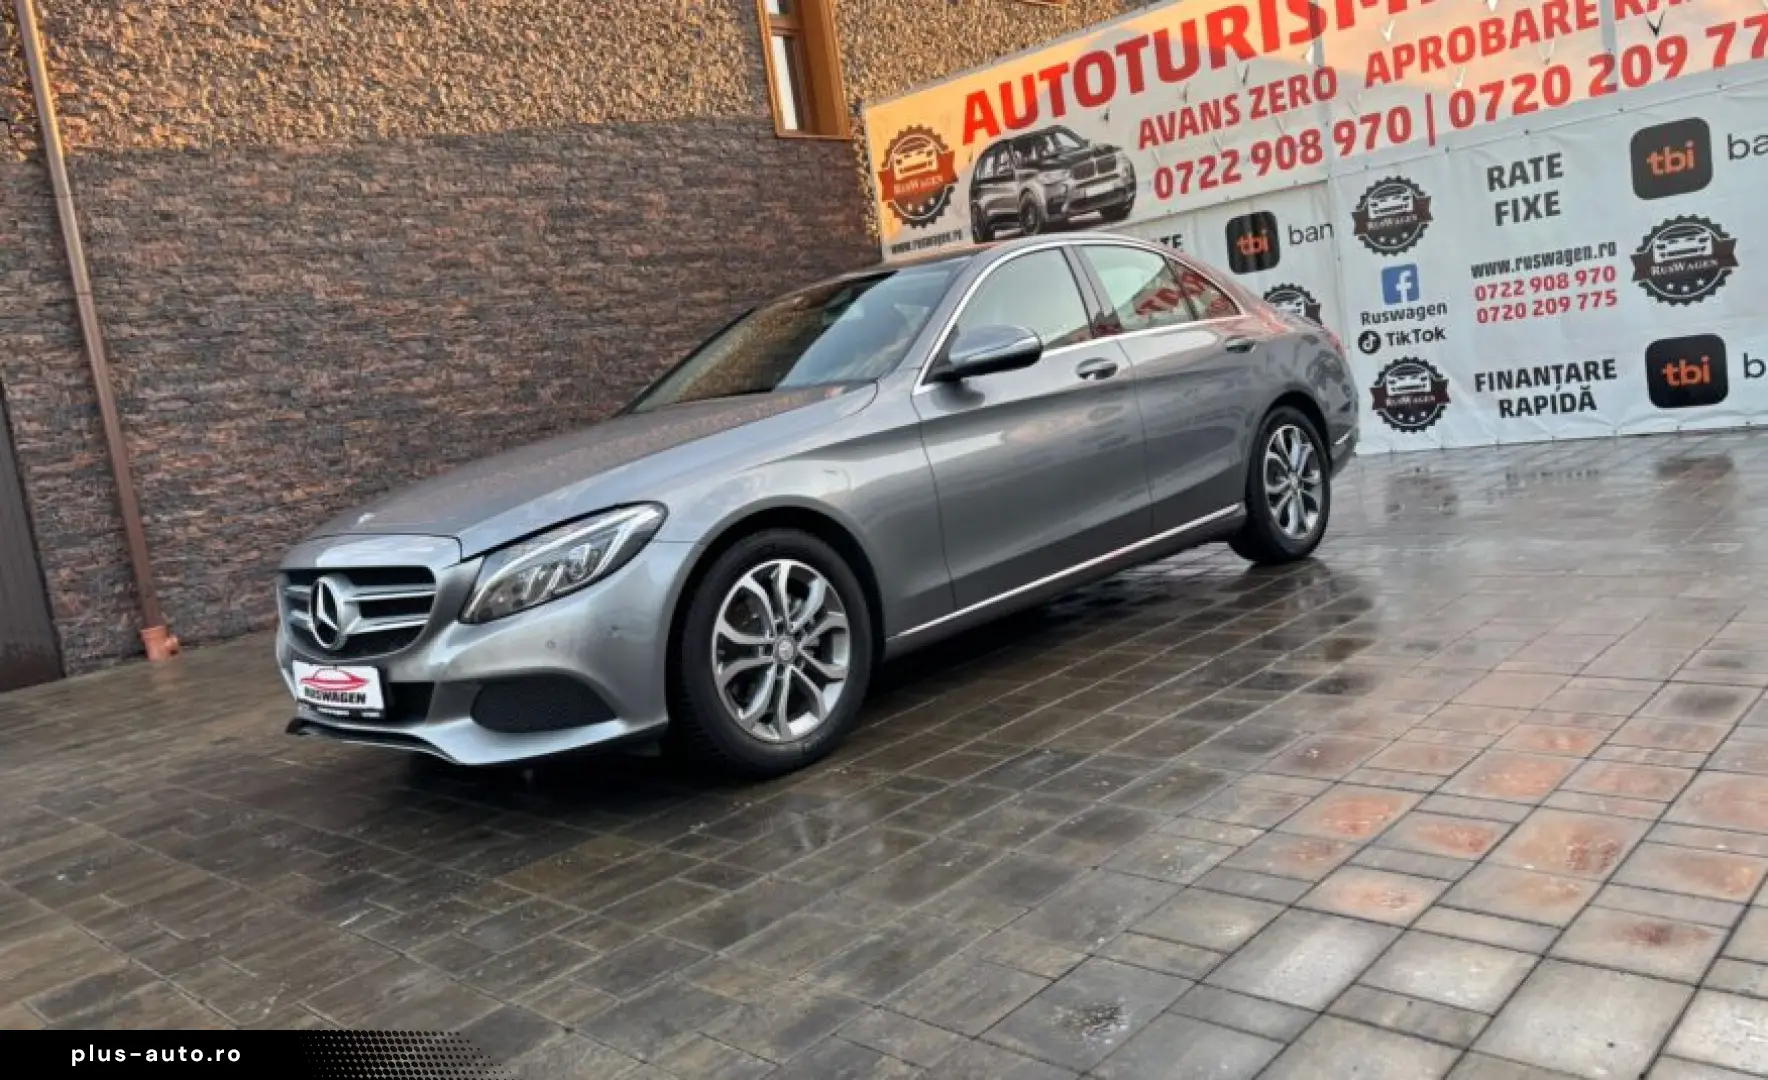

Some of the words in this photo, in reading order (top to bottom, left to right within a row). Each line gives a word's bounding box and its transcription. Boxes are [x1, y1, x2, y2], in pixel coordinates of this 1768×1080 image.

[1138, 93, 1240, 150] AVANS
[1249, 66, 1337, 120] ZERO
[1365, 0, 1599, 89] APROBARE
[1154, 149, 1241, 200] 0722
[1251, 128, 1323, 176] 908
[1333, 106, 1411, 156] 970
[1449, 64, 1571, 130] 0720
[1588, 35, 1688, 97] 209
[1487, 152, 1564, 192] RATE
[1644, 140, 1694, 176] tbi
[1494, 190, 1561, 227] FIXE
[1471, 241, 1617, 279] www.ruswagen.ro
[1475, 279, 1525, 302] 0722
[1530, 272, 1569, 293] 908
[1575, 265, 1617, 287] 970
[1360, 302, 1448, 326] Ruswagen
[1476, 302, 1527, 324] 0720
[1533, 296, 1571, 316] 209
[1576, 288, 1618, 312] 775
[1385, 326, 1447, 346] TikTok
[1662, 355, 1710, 388] tbi
[1499, 385, 1597, 419] RAPIDĂ
